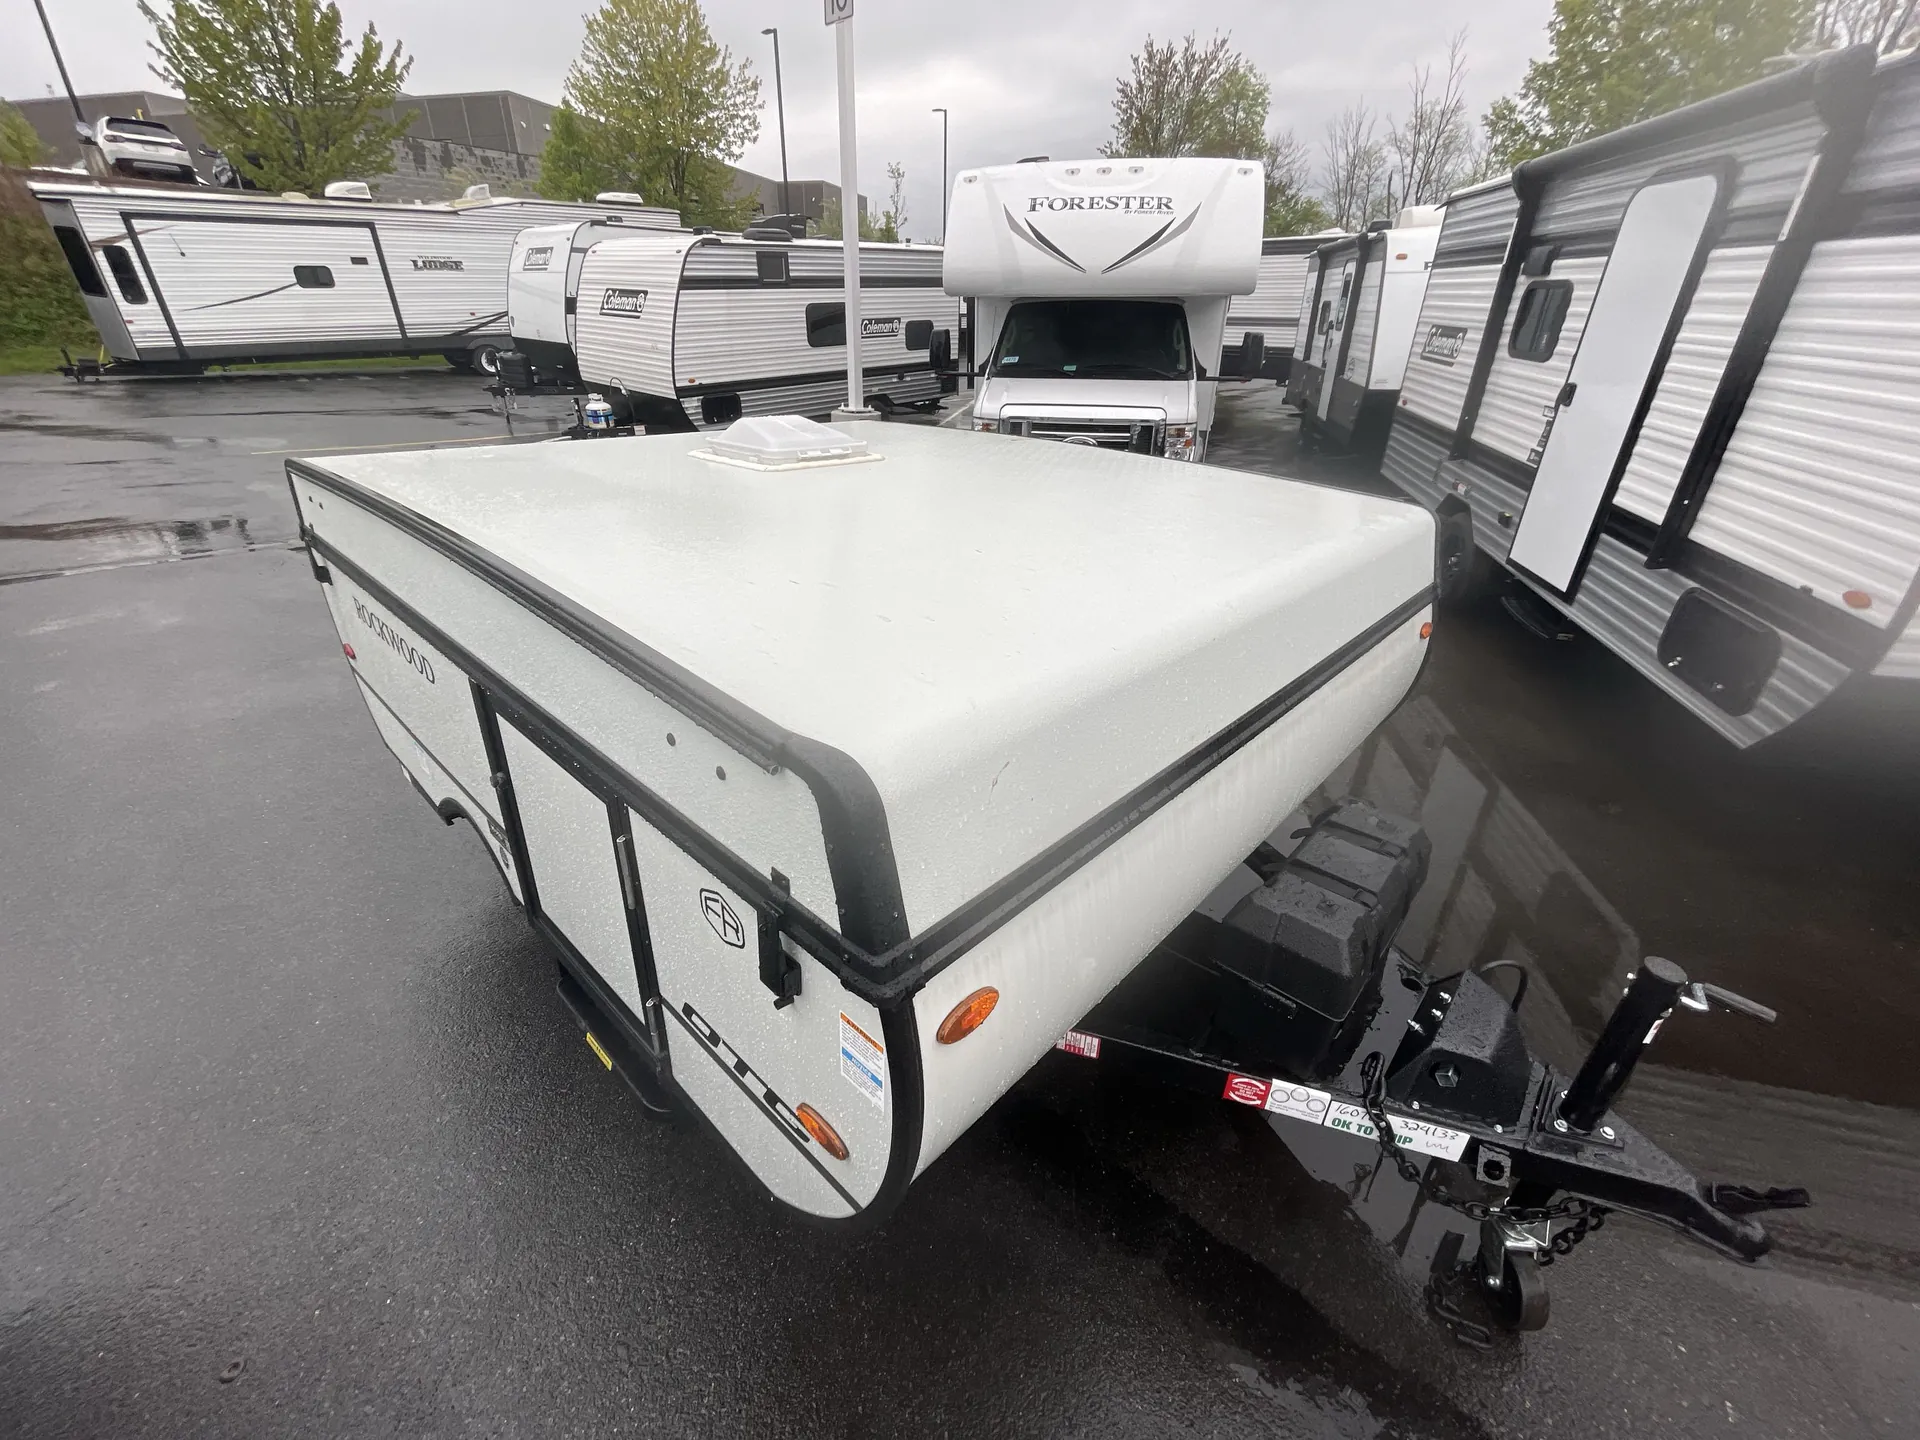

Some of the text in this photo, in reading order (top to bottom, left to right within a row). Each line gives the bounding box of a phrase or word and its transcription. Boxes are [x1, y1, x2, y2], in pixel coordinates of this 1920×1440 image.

[1027, 195, 1174, 212] FORESTER
[525, 249, 548, 266] Coleman
[603, 290, 637, 311] Coleman
[862, 319, 893, 335] Coleman
[353, 595, 435, 685] ROCKWOOD
[1331, 1117, 1351, 1134] OK
[1355, 1123, 1374, 1136] TO
